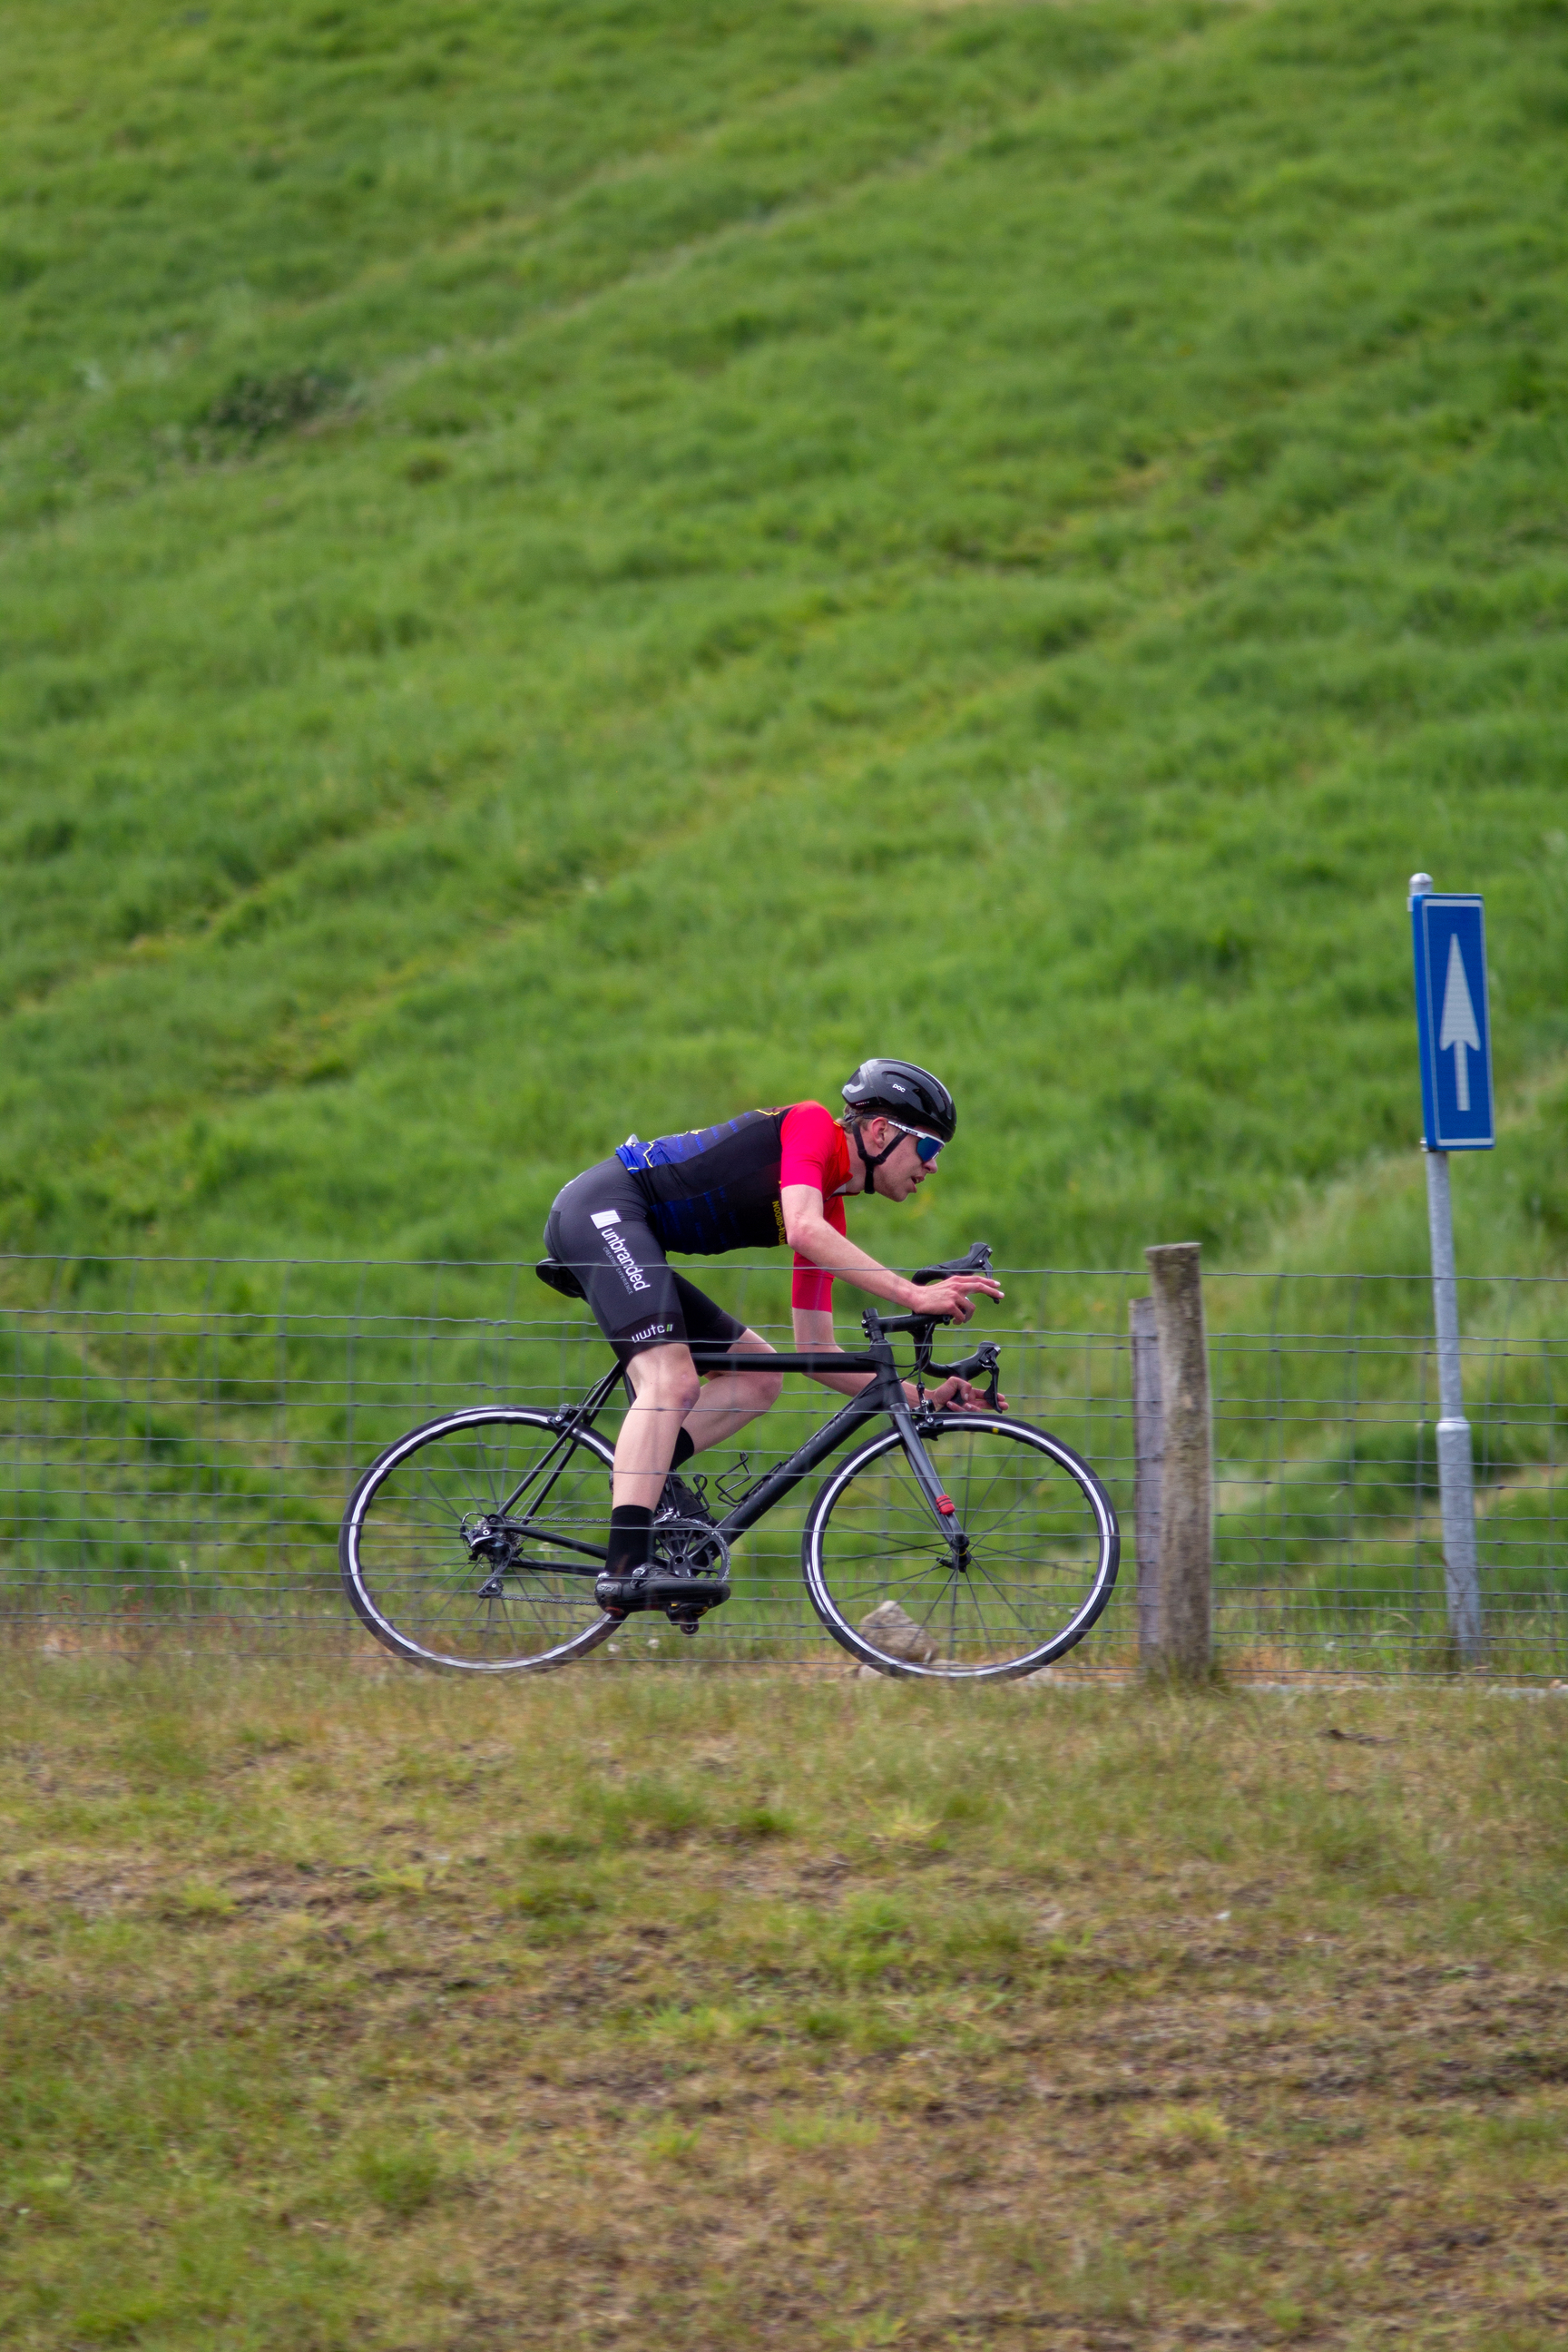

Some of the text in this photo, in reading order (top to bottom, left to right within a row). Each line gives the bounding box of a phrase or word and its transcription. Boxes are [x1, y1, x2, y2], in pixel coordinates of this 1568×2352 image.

[601, 1228, 651, 1291] unbranded
[603, 1247, 633, 1296] CREATIN EXPERIENCE
